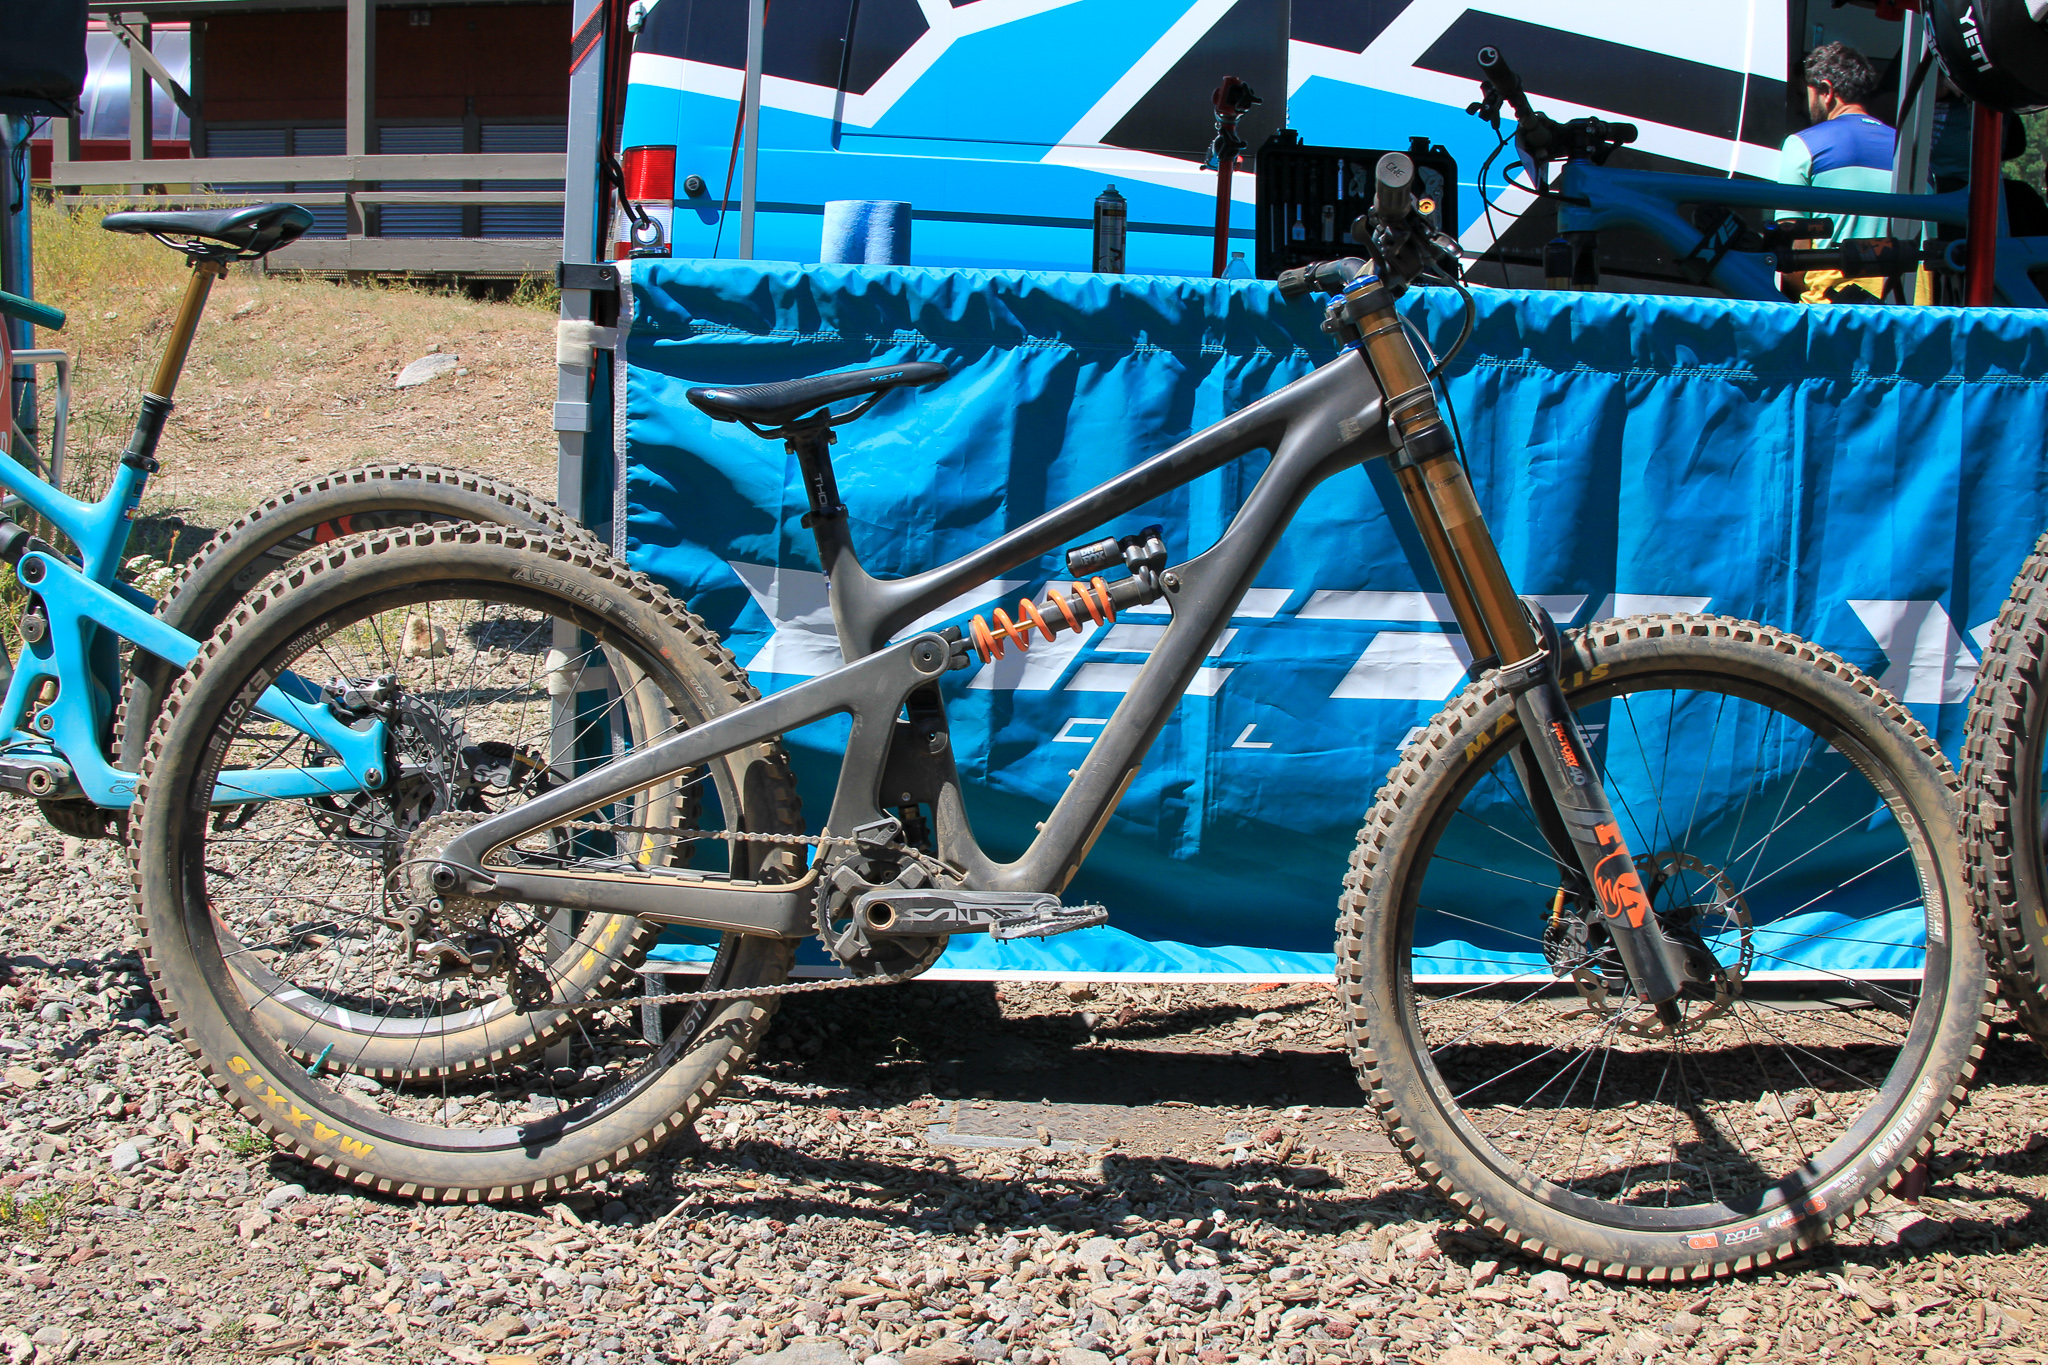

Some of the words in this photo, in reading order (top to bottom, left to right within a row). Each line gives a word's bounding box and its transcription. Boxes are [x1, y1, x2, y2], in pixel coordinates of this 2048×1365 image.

[1959, 5, 1993, 72] YETI
[869, 371, 904, 383] YETI
[1082, 550, 1106, 564] FOX
[512, 564, 615, 614] ASSEGAI
[315, 622, 330, 635] DT
[287, 632, 313, 653] SWISS
[1552, 722, 1580, 767] FACTORY
[1569, 765, 1587, 787] 40
[1931, 889, 1943, 919] SWISS
[1933, 922, 1944, 937] DT
[226, 1055, 375, 1160] MAXXIS
[1869, 1075, 1938, 1168] ASSEGAI
[1725, 1226, 1763, 1246] TR
